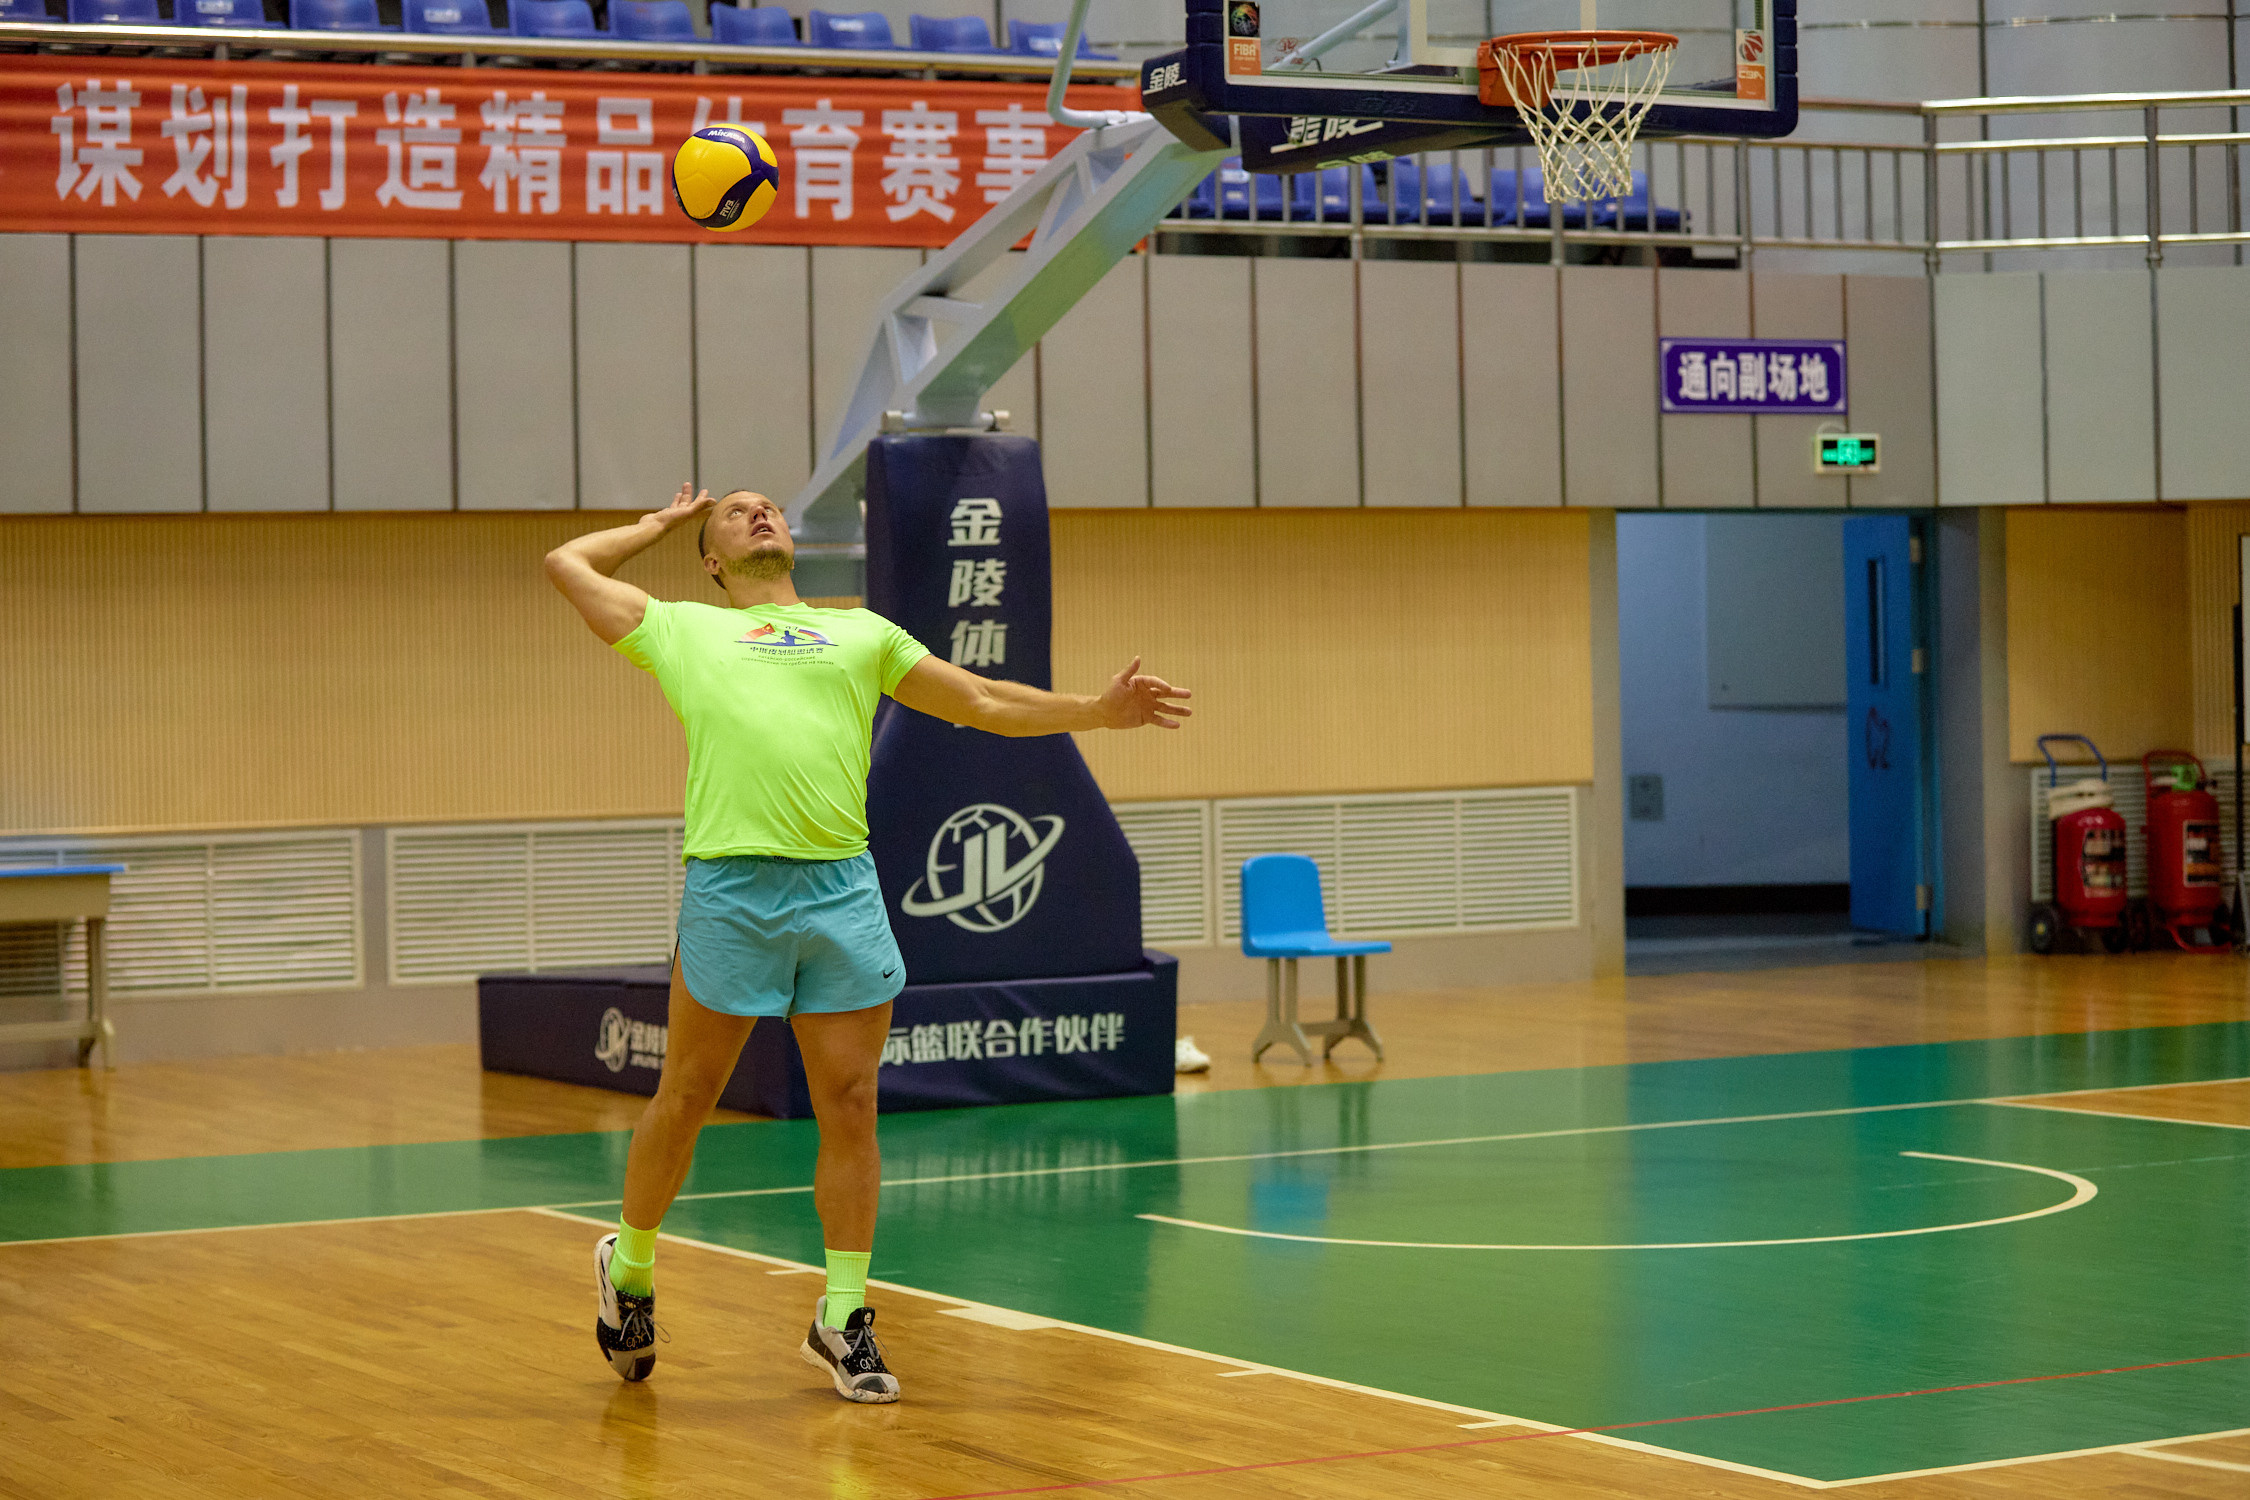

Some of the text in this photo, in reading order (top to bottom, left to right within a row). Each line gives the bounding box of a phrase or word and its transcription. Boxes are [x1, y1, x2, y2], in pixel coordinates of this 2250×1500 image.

[1233, 43, 1256, 56] FIBA
[1143, 62, 1187, 96] 金陵
[1678, 351, 1829, 402] 通向副场地
[947, 497, 1008, 728] 金陵体
